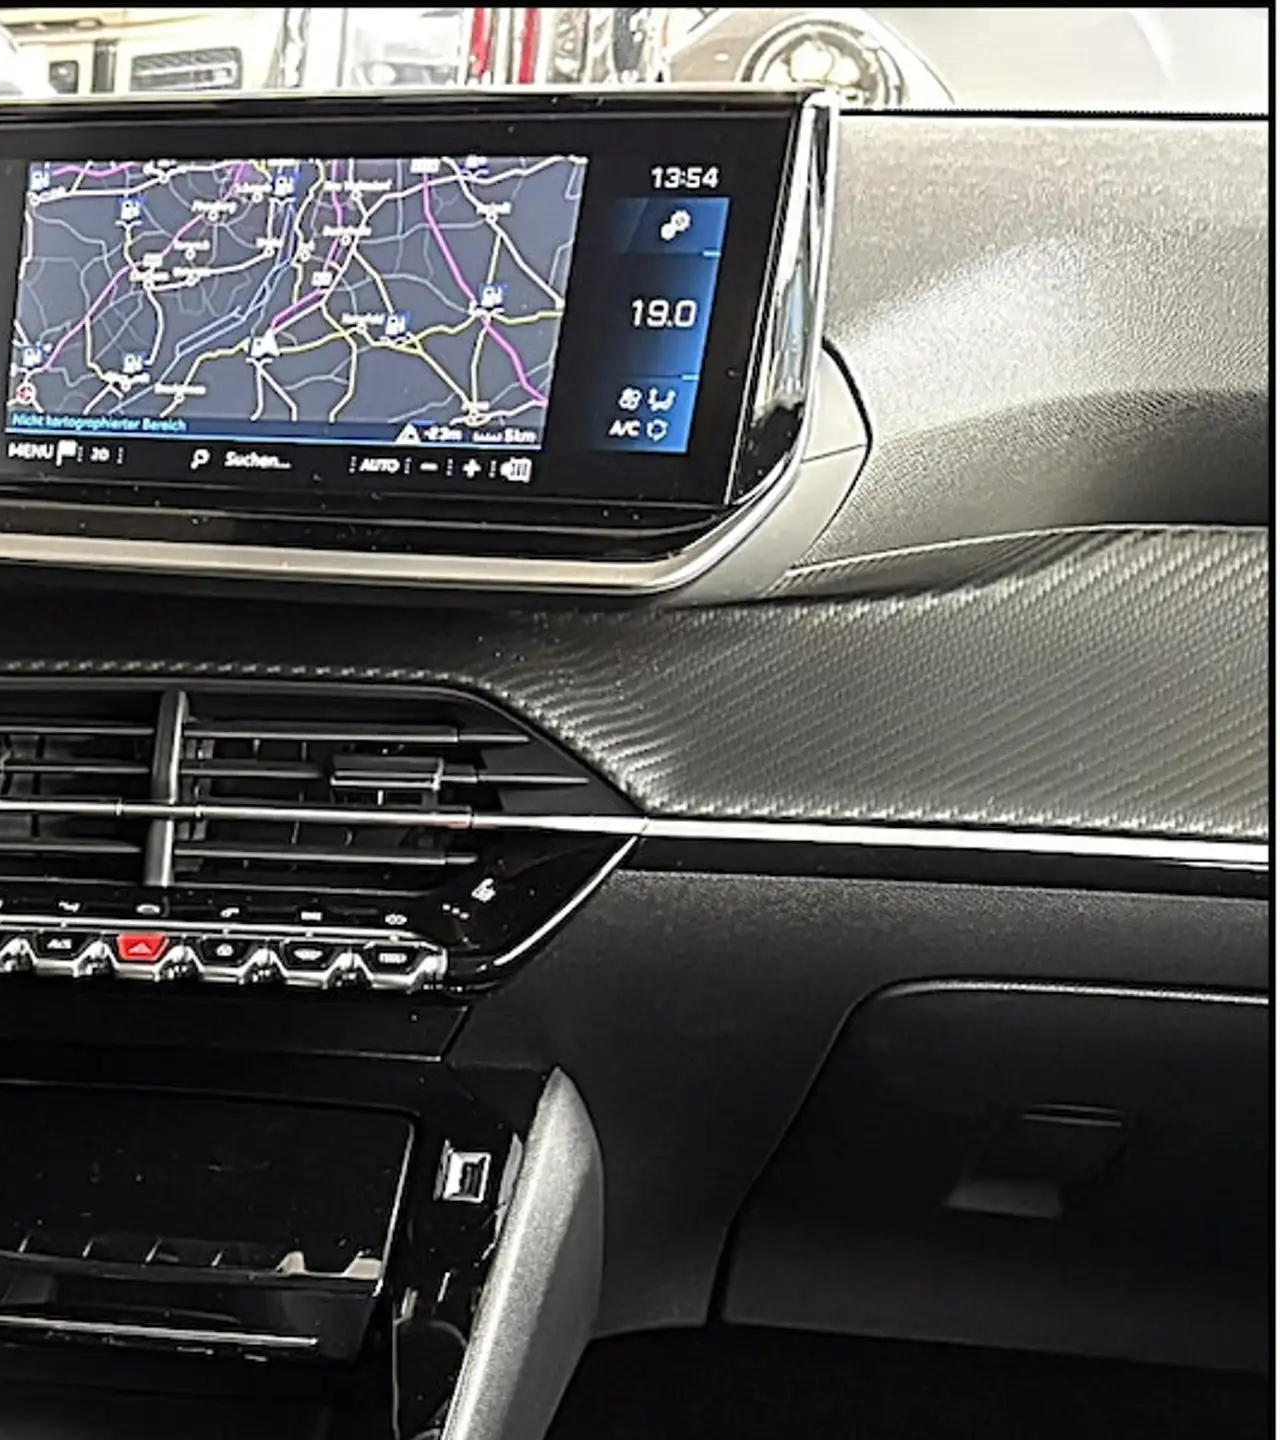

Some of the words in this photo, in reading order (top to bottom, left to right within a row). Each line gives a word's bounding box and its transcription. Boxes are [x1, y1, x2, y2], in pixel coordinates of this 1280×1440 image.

[651, 166, 719, 189] 13:54
[631, 299, 697, 328] 19.0
[12, 413, 43, 426] Nicht
[142, 417, 187, 431] Bereich
[608, 419, 641, 436] A/C
[8, 442, 54, 460] MENU
[359, 458, 400, 473] AUTO
